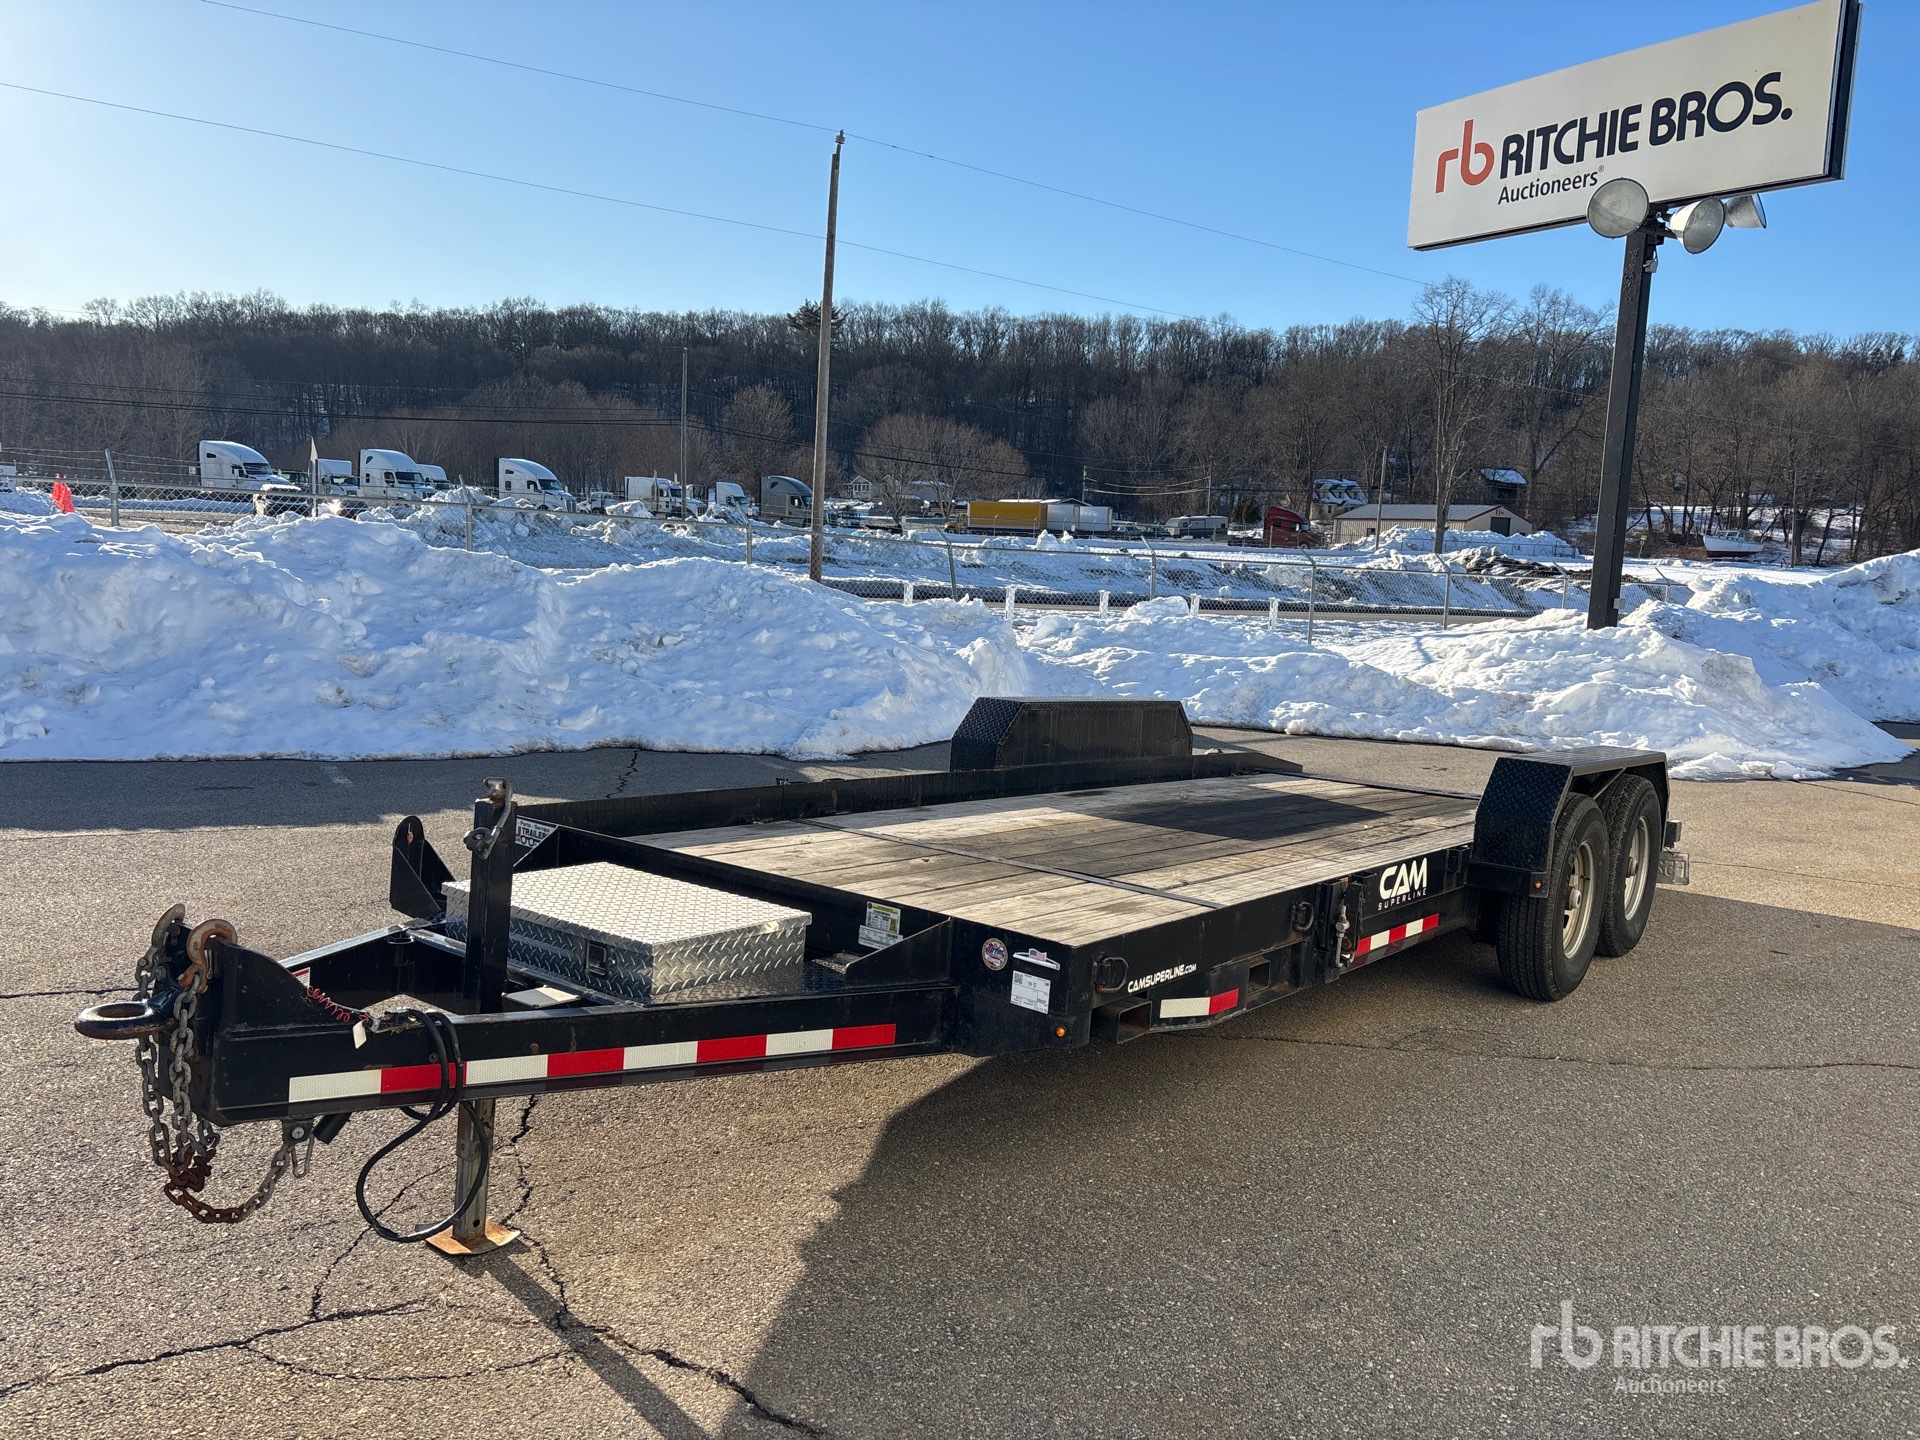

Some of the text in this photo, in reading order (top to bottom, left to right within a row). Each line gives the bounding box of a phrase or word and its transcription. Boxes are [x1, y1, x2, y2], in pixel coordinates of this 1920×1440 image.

[1499, 71, 1794, 180] RITCHIE BROS.
[1377, 887, 1428, 911] SUPERLINE
[1379, 857, 1428, 900] CAM
